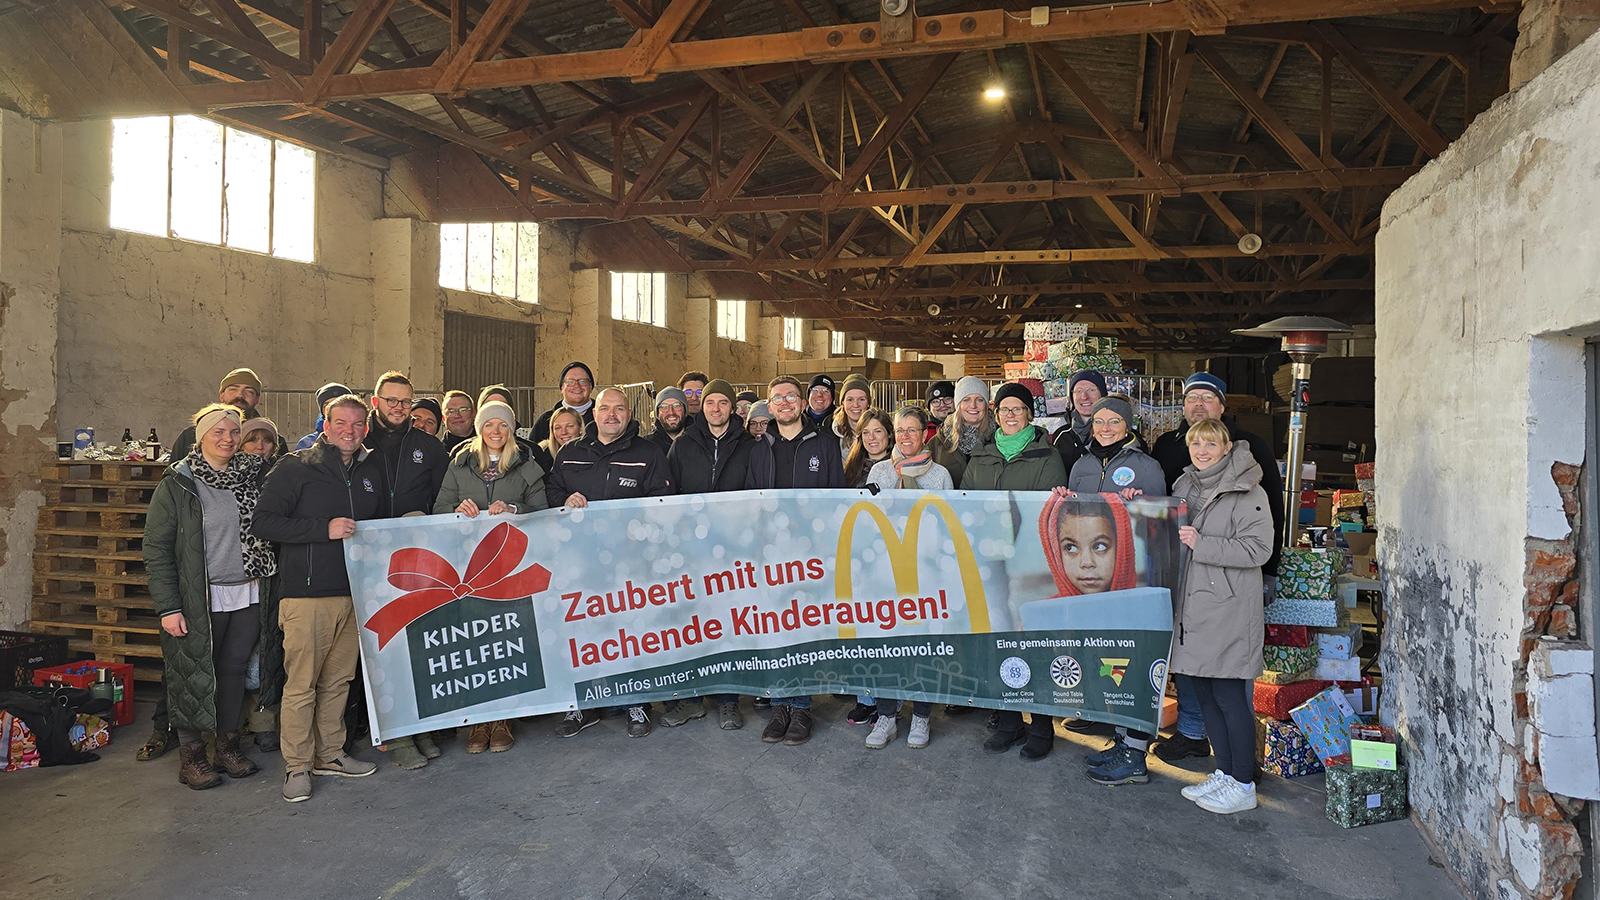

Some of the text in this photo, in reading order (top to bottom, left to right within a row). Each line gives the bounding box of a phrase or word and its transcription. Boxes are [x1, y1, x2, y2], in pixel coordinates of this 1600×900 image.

[561, 558, 824, 622] Zaubert mit uns
[423, 612, 521, 649] KINDER
[569, 589, 949, 668] lachende Kinderaugen!
[996, 637, 1136, 650] Eine gemeinsame Aktion von
[428, 637, 524, 676] HELFEN
[584, 641, 954, 702] Alle Infos unter: www.weihnachtspaeckchenkonvoi.de
[431, 662, 528, 699] KINDERN
[1102, 691, 1123, 699] Tangent
[1104, 698, 1135, 706] Deutschland
